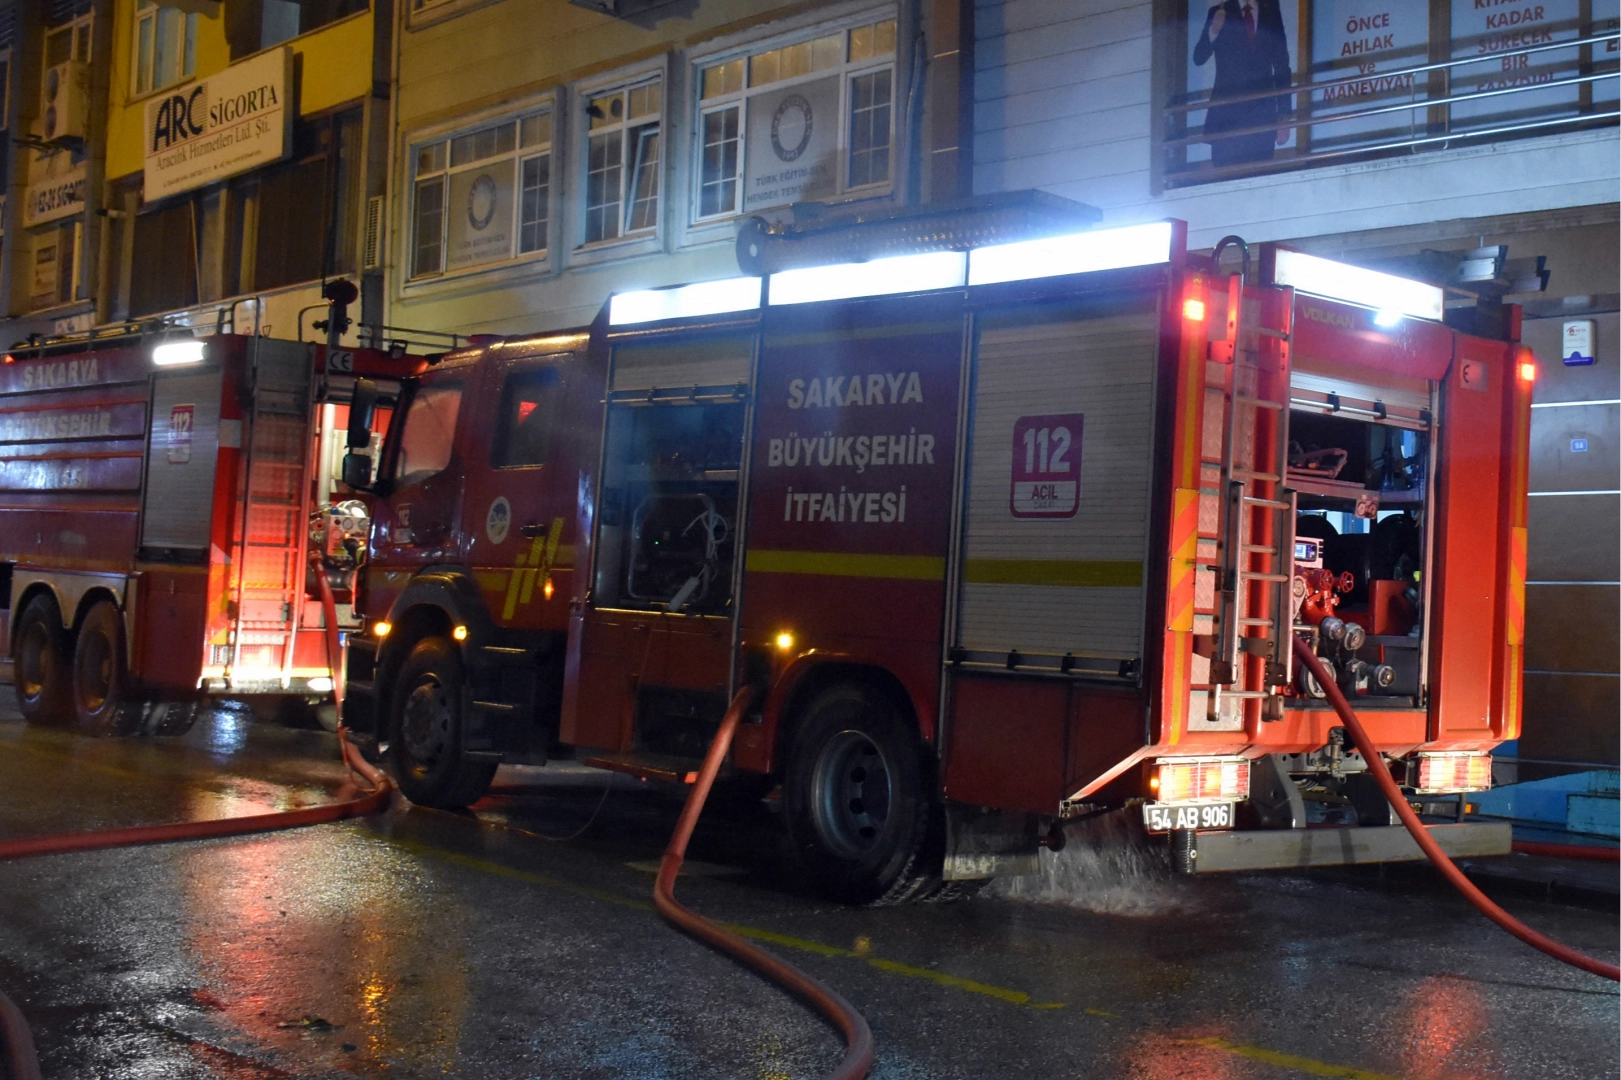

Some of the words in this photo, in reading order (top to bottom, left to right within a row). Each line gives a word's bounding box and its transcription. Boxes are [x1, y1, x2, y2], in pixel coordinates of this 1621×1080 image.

[1346, 13, 1390, 34] ÖNCE
[1486, 6, 1545, 29] KADAR
[1341, 34, 1395, 56] AHLAK
[1358, 62, 1376, 74] ve
[153, 85, 204, 151] ARC
[209, 83, 278, 128] SİGORTA
[190, 130, 233, 160] Hizmetleri
[756, 174, 778, 187] TÜRK
[24, 358, 98, 388] SAKARYA
[787, 371, 923, 410] SAKARYA
[768, 426, 935, 473] BÜYÜKŞEHİR
[1023, 426, 1072, 473] 112
[784, 485, 906, 522] İTFAİYESİ
[1151, 809, 1172, 830] 54
[1176, 807, 1199, 829] AB
[1202, 805, 1228, 827] 906
